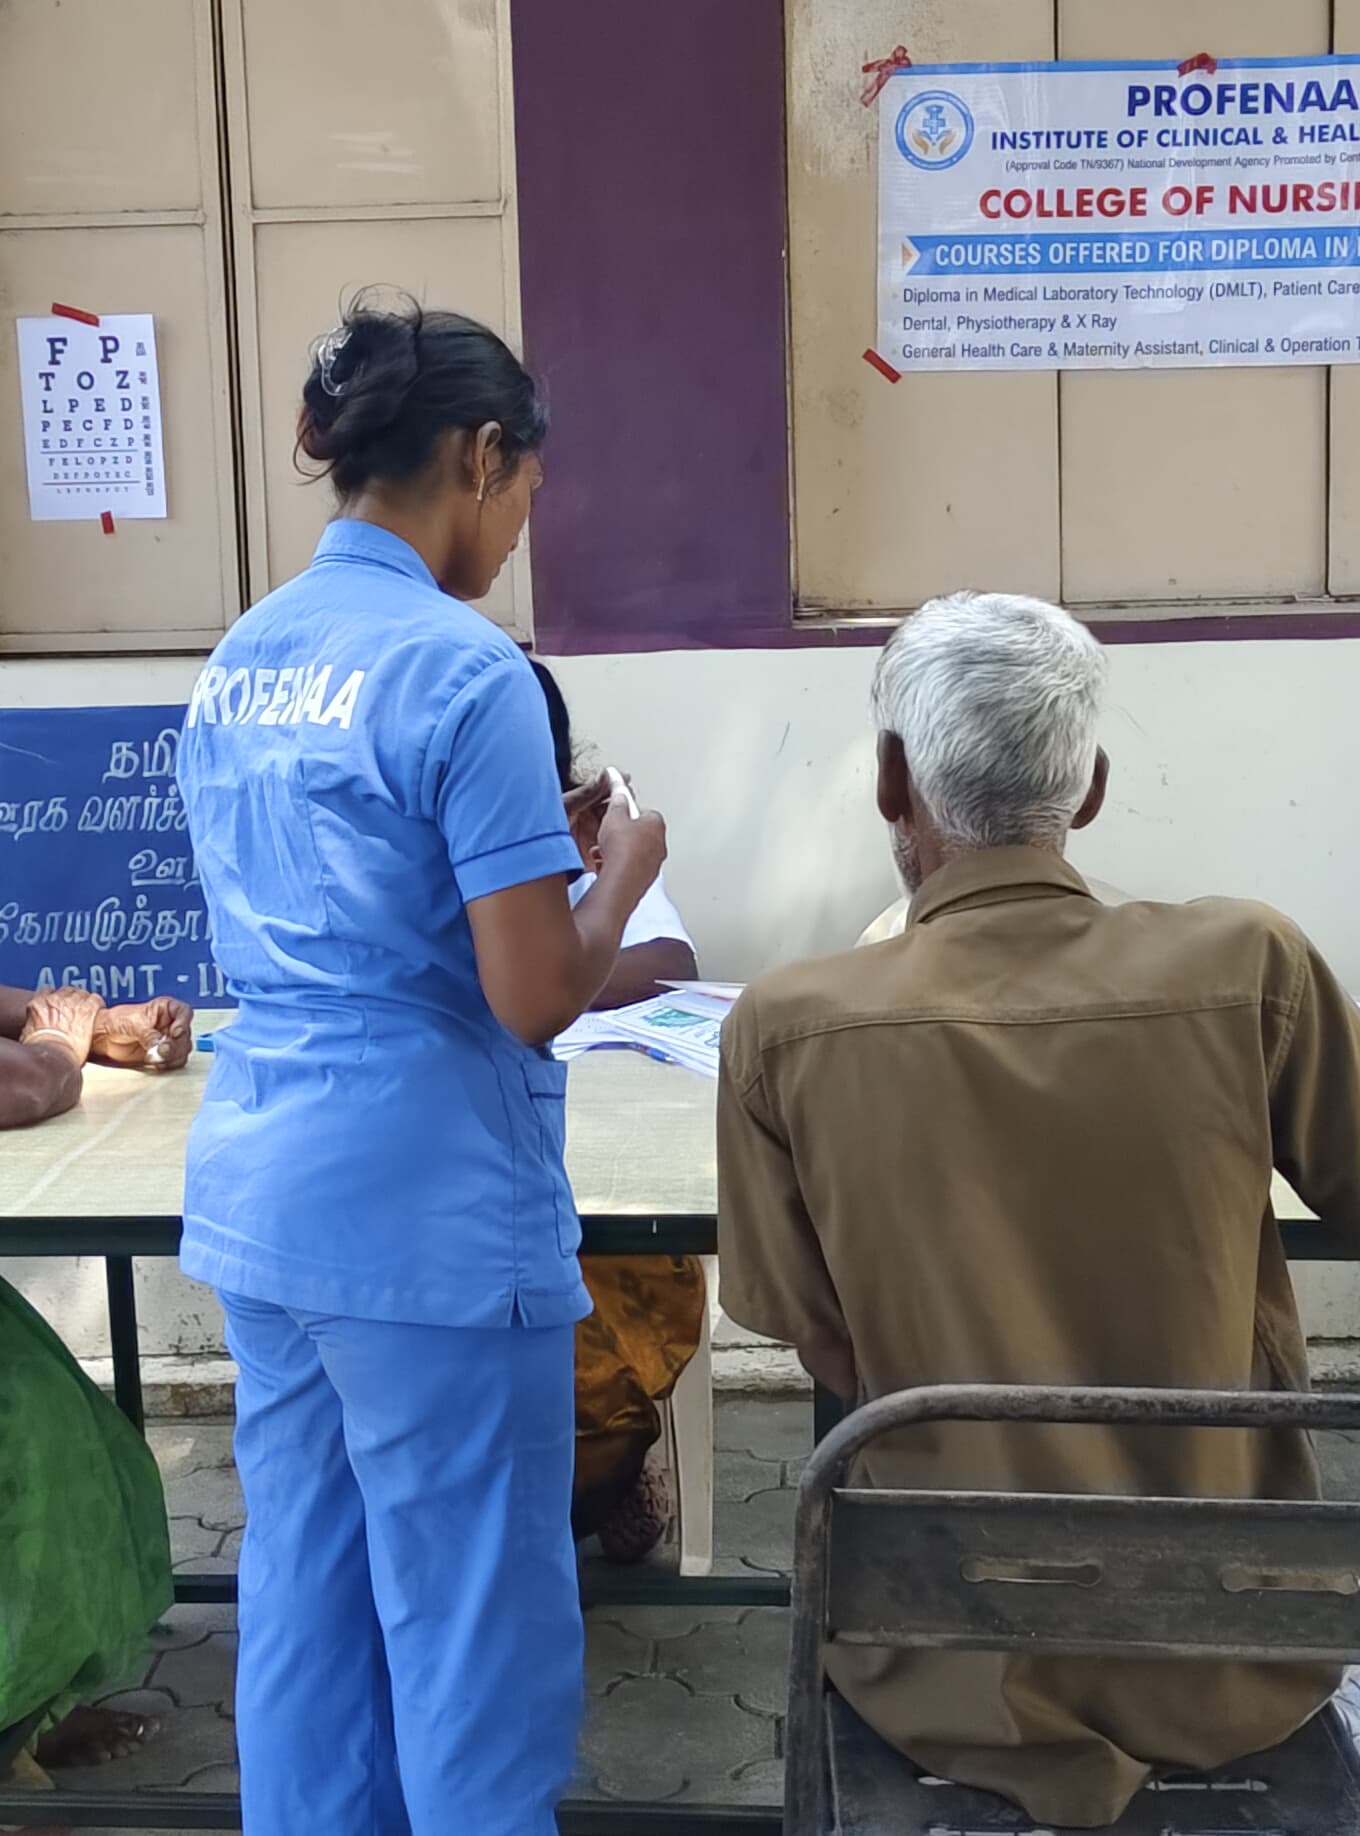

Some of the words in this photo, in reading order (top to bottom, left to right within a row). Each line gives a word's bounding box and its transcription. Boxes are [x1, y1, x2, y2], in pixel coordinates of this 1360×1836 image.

[1127, 79, 1360, 117] PROFENAA
[991, 130, 1108, 150] INSTITUTE
[1116, 129, 1149, 148] OF
[1156, 127, 1263, 147] CLINICAL
[1272, 126, 1289, 145] &
[1005, 158, 1051, 172] (Approval
[1053, 158, 1077, 170] Code
[1127, 157, 1166, 169] National
[1168, 156, 1232, 170] Development
[1234, 156, 1270, 168] Agency
[1273, 154, 1321, 166] Promoted
[1324, 153, 1337, 165] by
[979, 187, 1148, 219] COLLEGE
[1162, 185, 1214, 216] OF
[935, 243, 1041, 267] COURSES
[1048, 241, 1150, 264] OFFERED
[1158, 239, 1203, 262] FOR
[1211, 237, 1317, 261] DIPLOMA
[1325, 236, 1349, 258] IN
[903, 288, 960, 306] Diploma
[965, 287, 978, 301] in
[983, 286, 1038, 301] Medical
[1043, 285, 1118, 304] Laboratory
[1124, 284, 1203, 301] Technology
[1209, 282, 1266, 300] (DMLT),
[1273, 281, 1322, 296] Patient
[1327, 280, 1360, 295] Care
[903, 316, 951, 332] Dental,
[957, 314, 1056, 332] Physiotherapy
[1060, 315, 1071, 329] &
[1076, 314, 1087, 328] X
[1092, 314, 1117, 330] Ray
[46, 337, 68, 366] F
[98, 335, 120, 364] P
[902, 344, 956, 359] General
[961, 343, 1005, 358] Health
[1010, 343, 1042, 356] Care
[1048, 342, 1058, 356] &
[1064, 342, 1130, 358] Maternity
[1134, 340, 1203, 355] Assistant,
[1209, 338, 1259, 354] Clinical
[1264, 338, 1275, 353] &
[1280, 337, 1350, 354] Operation
[38, 372, 56, 392] T
[76, 371, 95, 391] O
[115, 370, 131, 390] Z
[188, 663, 366, 730] PROFENAA
